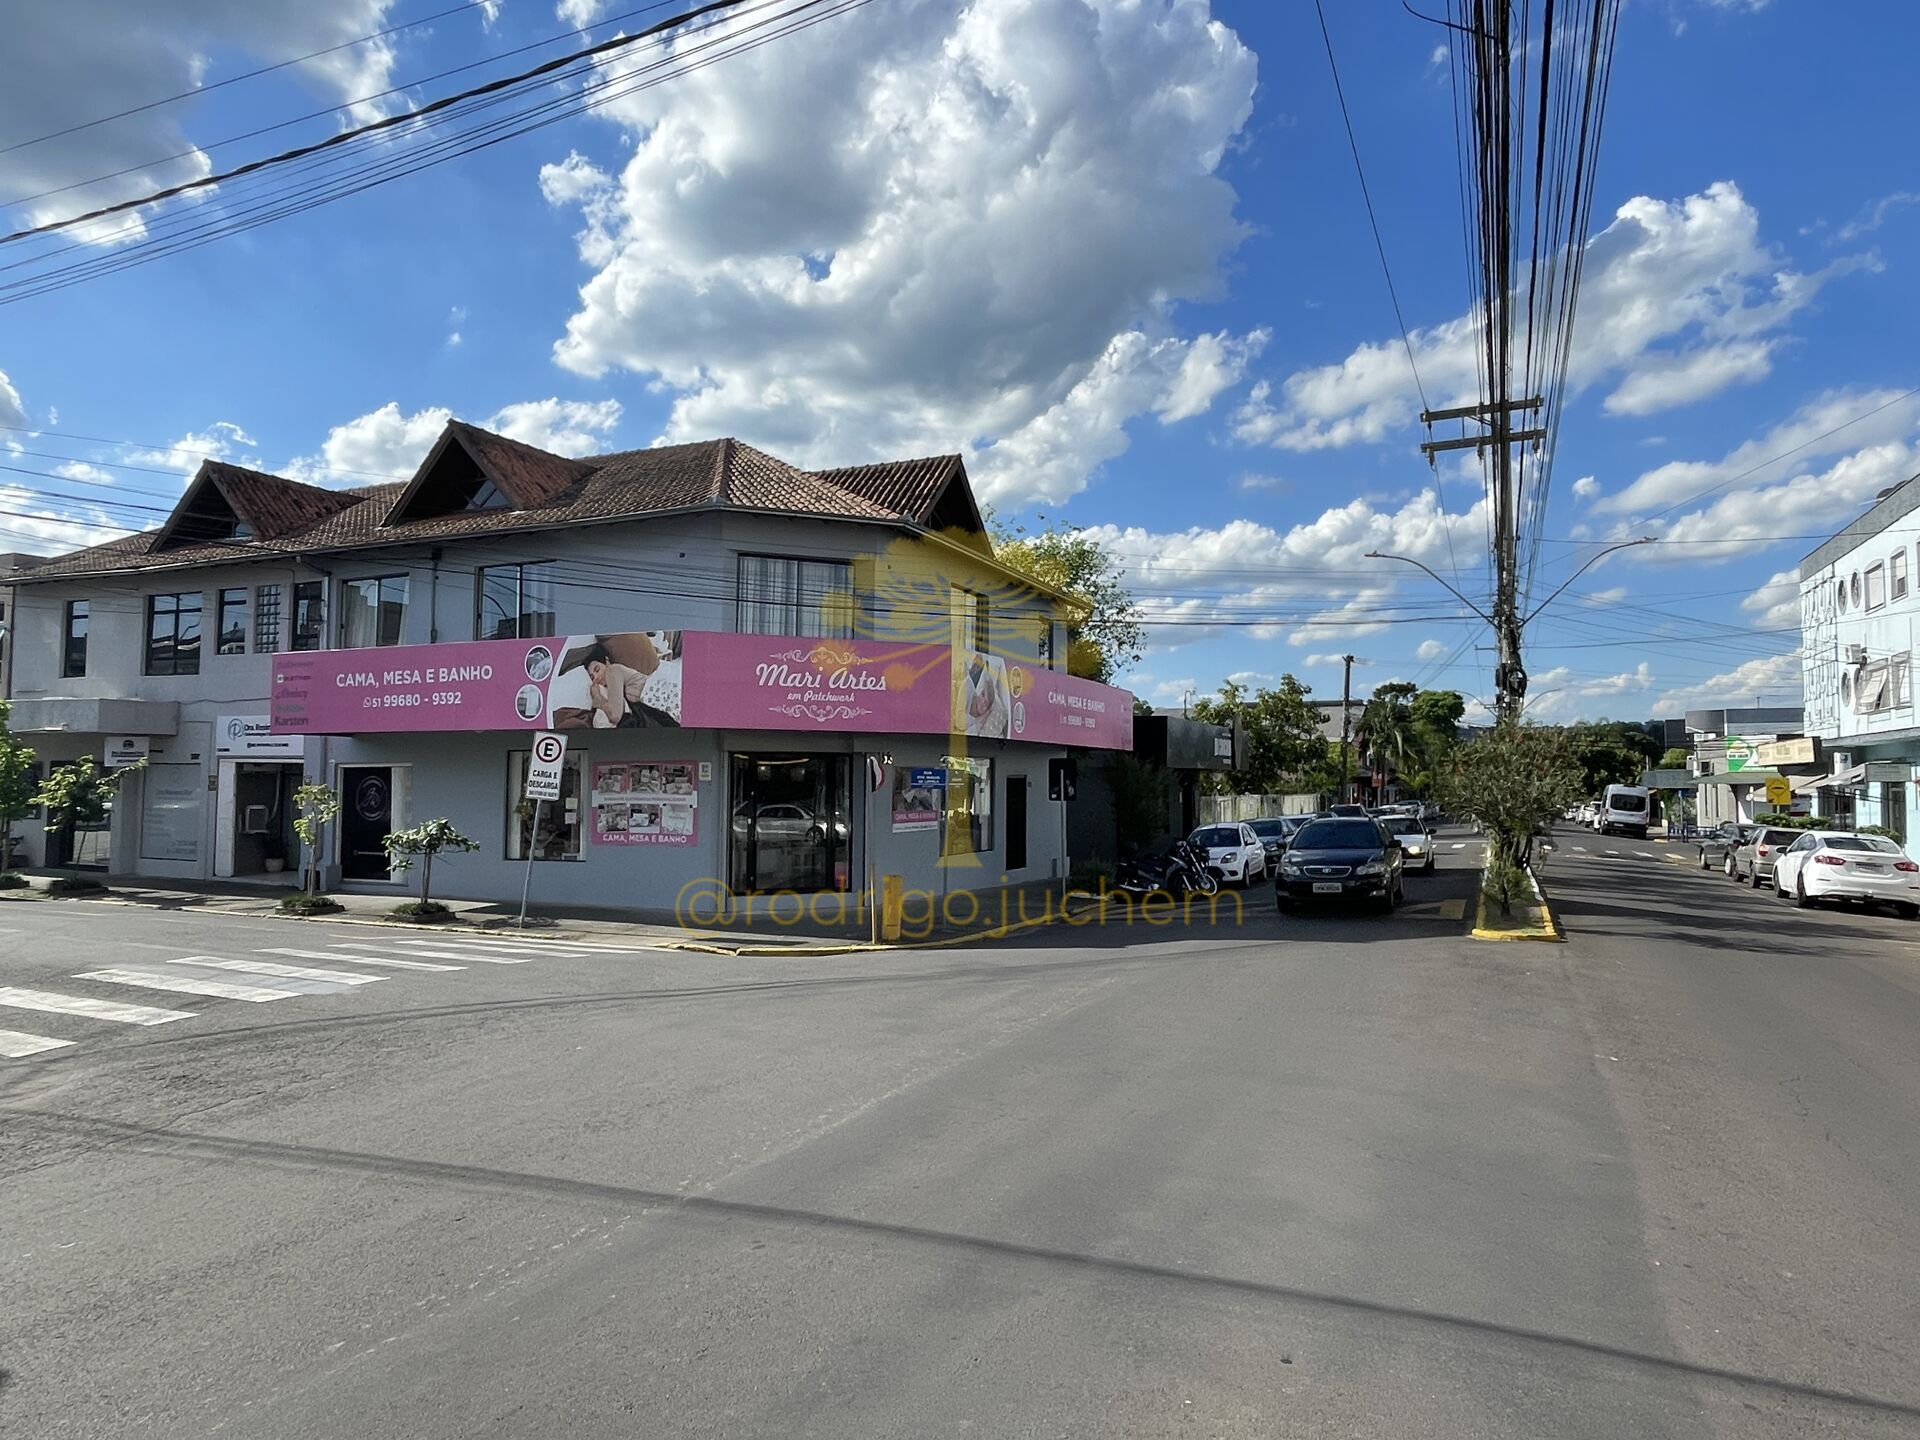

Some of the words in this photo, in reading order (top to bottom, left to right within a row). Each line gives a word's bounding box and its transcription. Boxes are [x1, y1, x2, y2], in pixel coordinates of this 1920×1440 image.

[336, 673, 380, 689] CAMA,
[383, 670, 422, 685] MESA
[426, 669, 435, 683] E
[438, 665, 493, 682] BANHO
[756, 663, 821, 688] Mari
[828, 667, 887, 691] Artes
[372, 697, 382, 708] 51
[383, 694, 421, 707] 99680
[432, 692, 462, 705] 9392
[787, 693, 801, 701] em
[803, 690, 855, 703] Patchwork
[1048, 691, 1067, 708] CAMA,
[543, 742, 554, 758] E
[533, 769, 552, 779] CARGA
[553, 771, 558, 780] E
[528, 780, 558, 791] DESCARGA
[602, 834, 627, 844] CAMA,
[629, 834, 650, 843] MESA
[651, 834, 658, 843] E
[658, 834, 688, 844] BANHO
